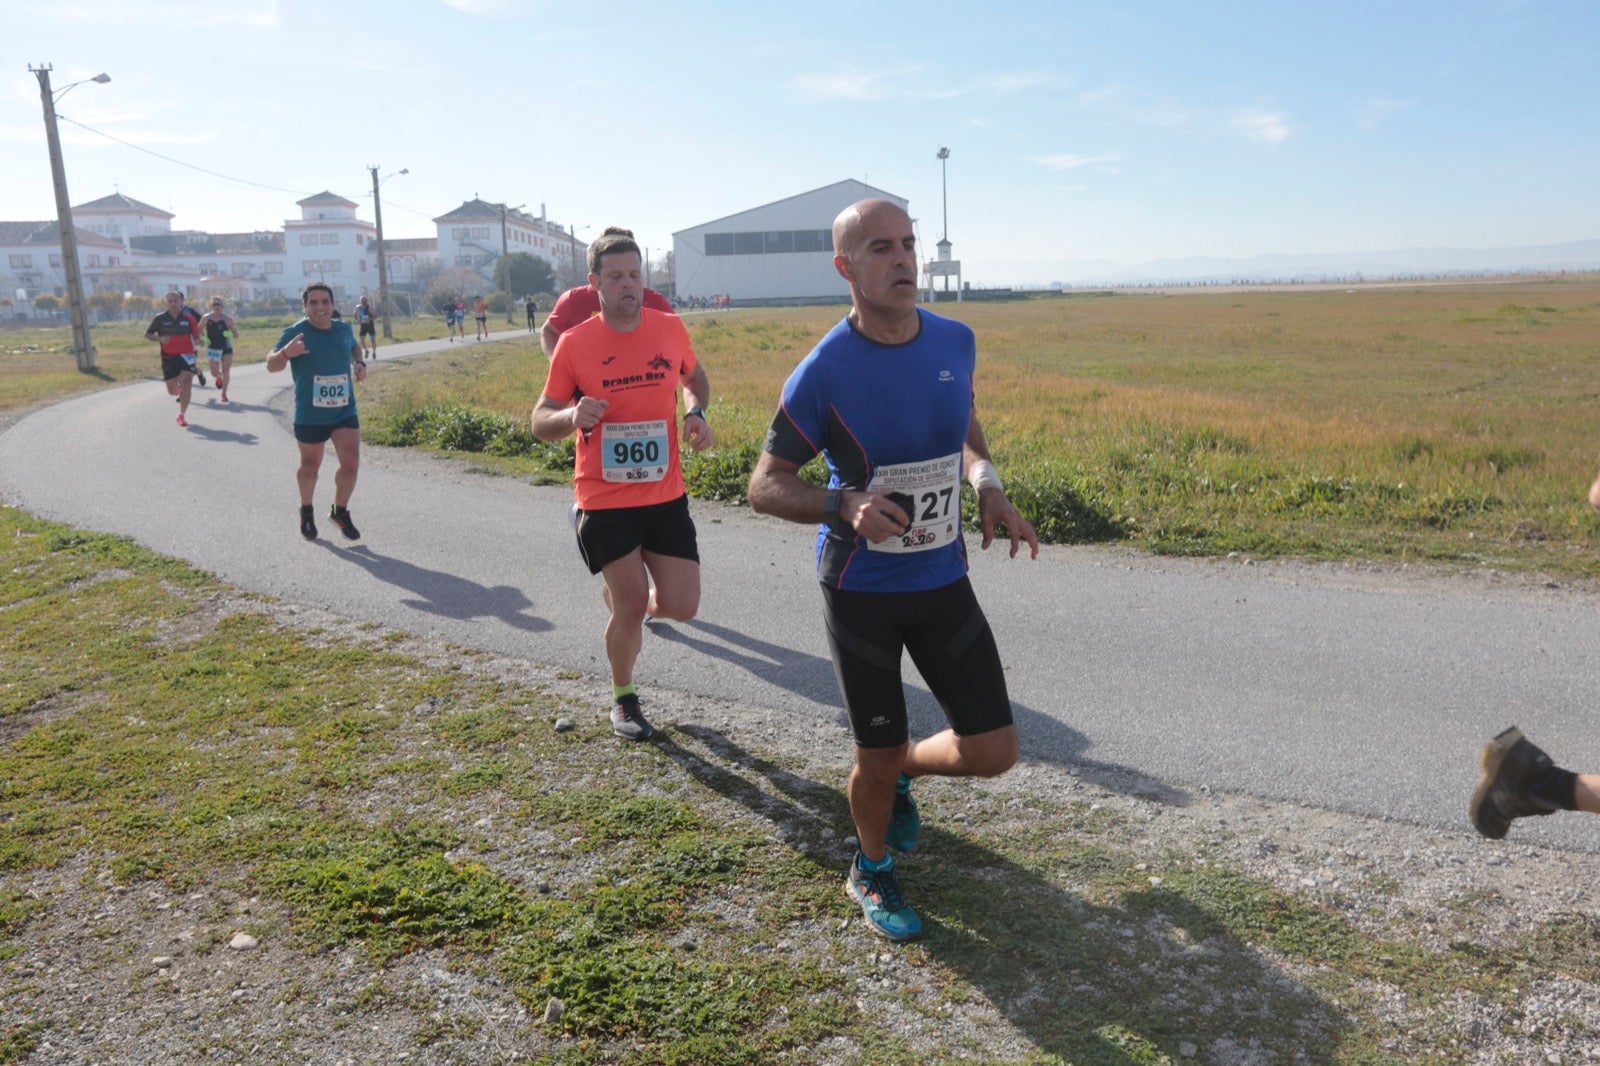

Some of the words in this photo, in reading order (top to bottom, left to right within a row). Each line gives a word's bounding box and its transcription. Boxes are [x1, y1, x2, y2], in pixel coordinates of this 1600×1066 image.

[602, 374, 643, 387] Dragón
[645, 372, 666, 380] Box
[320, 385, 344, 397] 602
[613, 440, 659, 464] 960
[889, 467, 907, 476] GRAN
[908, 465, 931, 475] PREMIO
[931, 463, 939, 472] DE
[939, 458, 955, 470] FONDO
[883, 475, 917, 484] DIPUTACIÓN
[925, 471, 948, 480] GRANADA
[911, 486, 954, 521] 27
